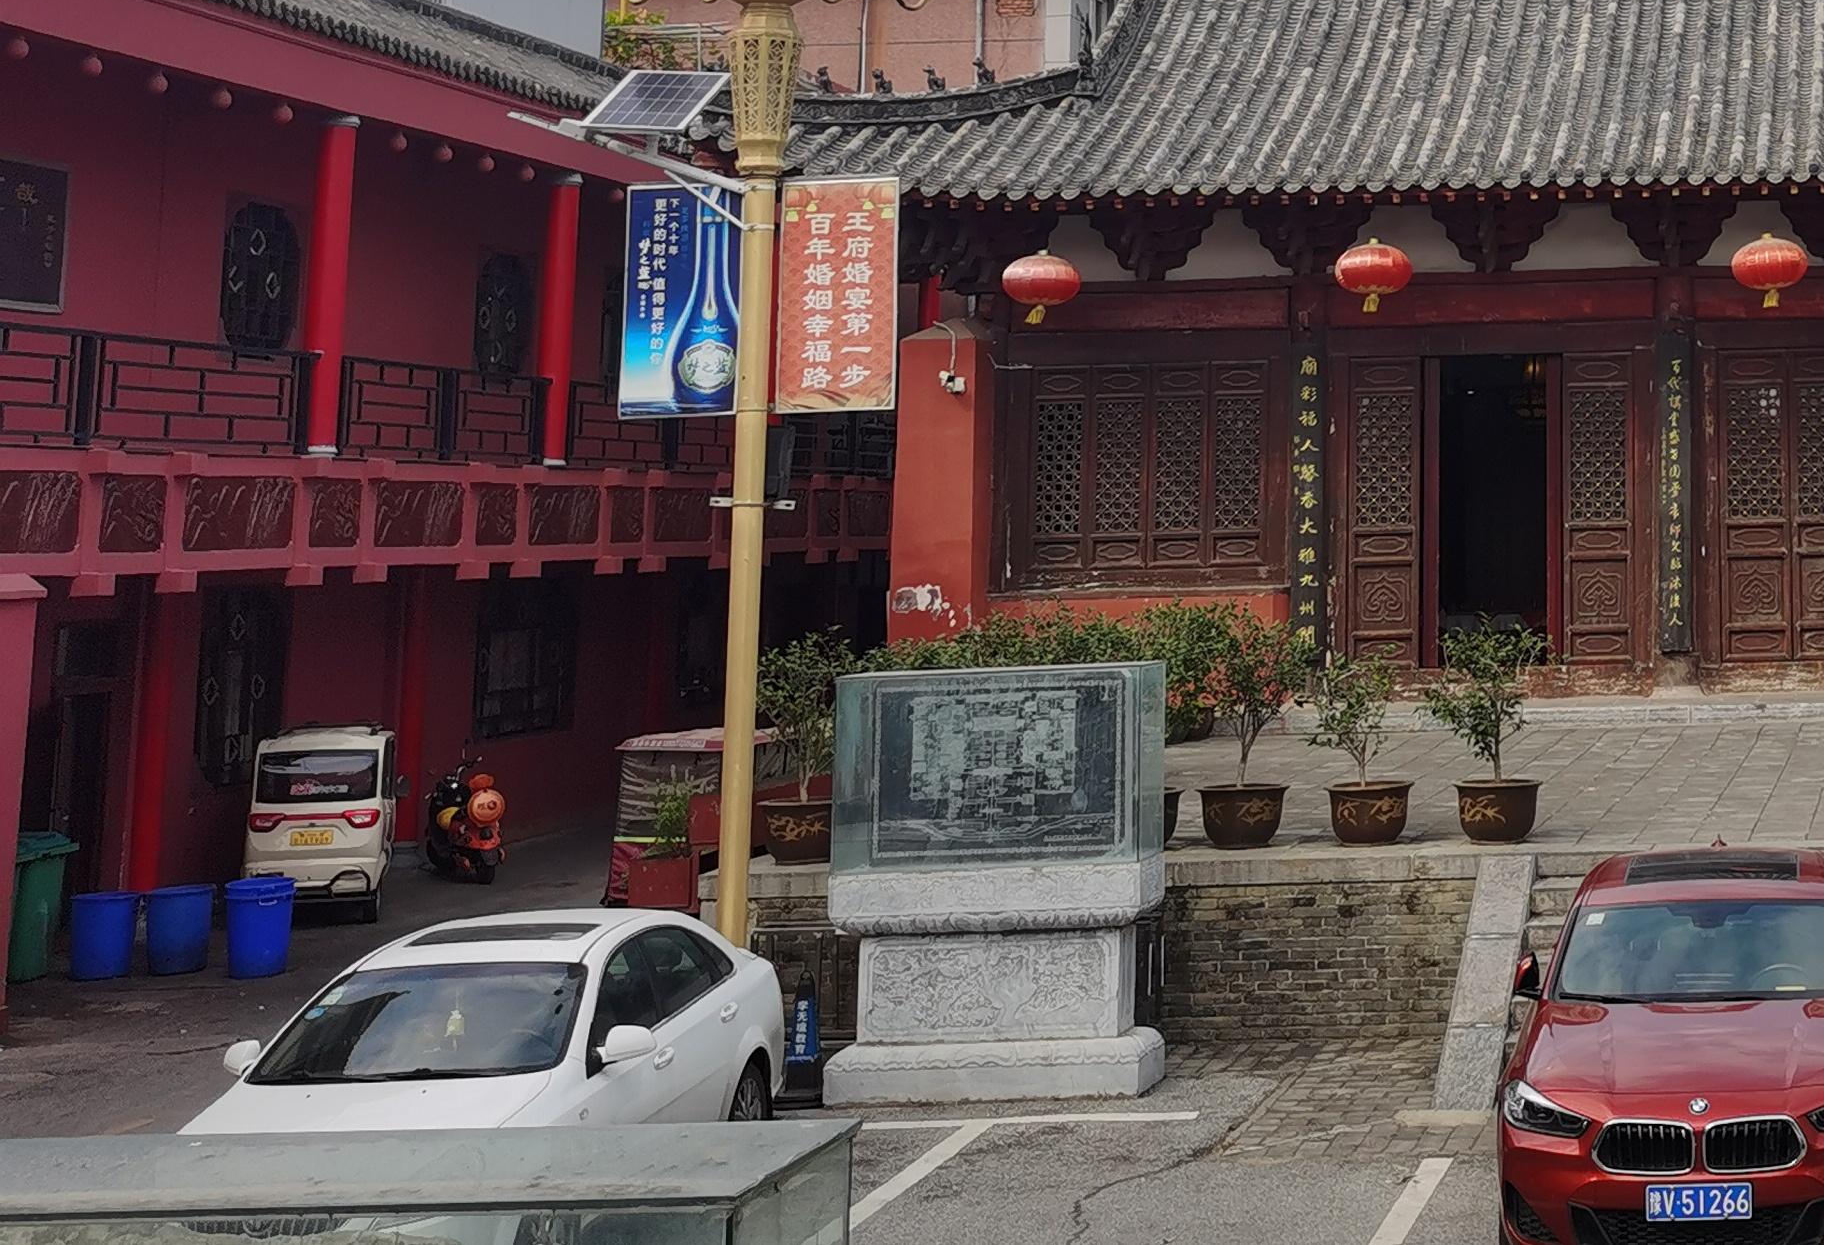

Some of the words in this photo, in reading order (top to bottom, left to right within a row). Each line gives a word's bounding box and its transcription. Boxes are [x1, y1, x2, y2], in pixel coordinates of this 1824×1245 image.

[668, 198, 681, 256] 下一个十年
[801, 212, 837, 390] 百年婚姻幸福路
[839, 212, 875, 389] 王府婚宴第一步
